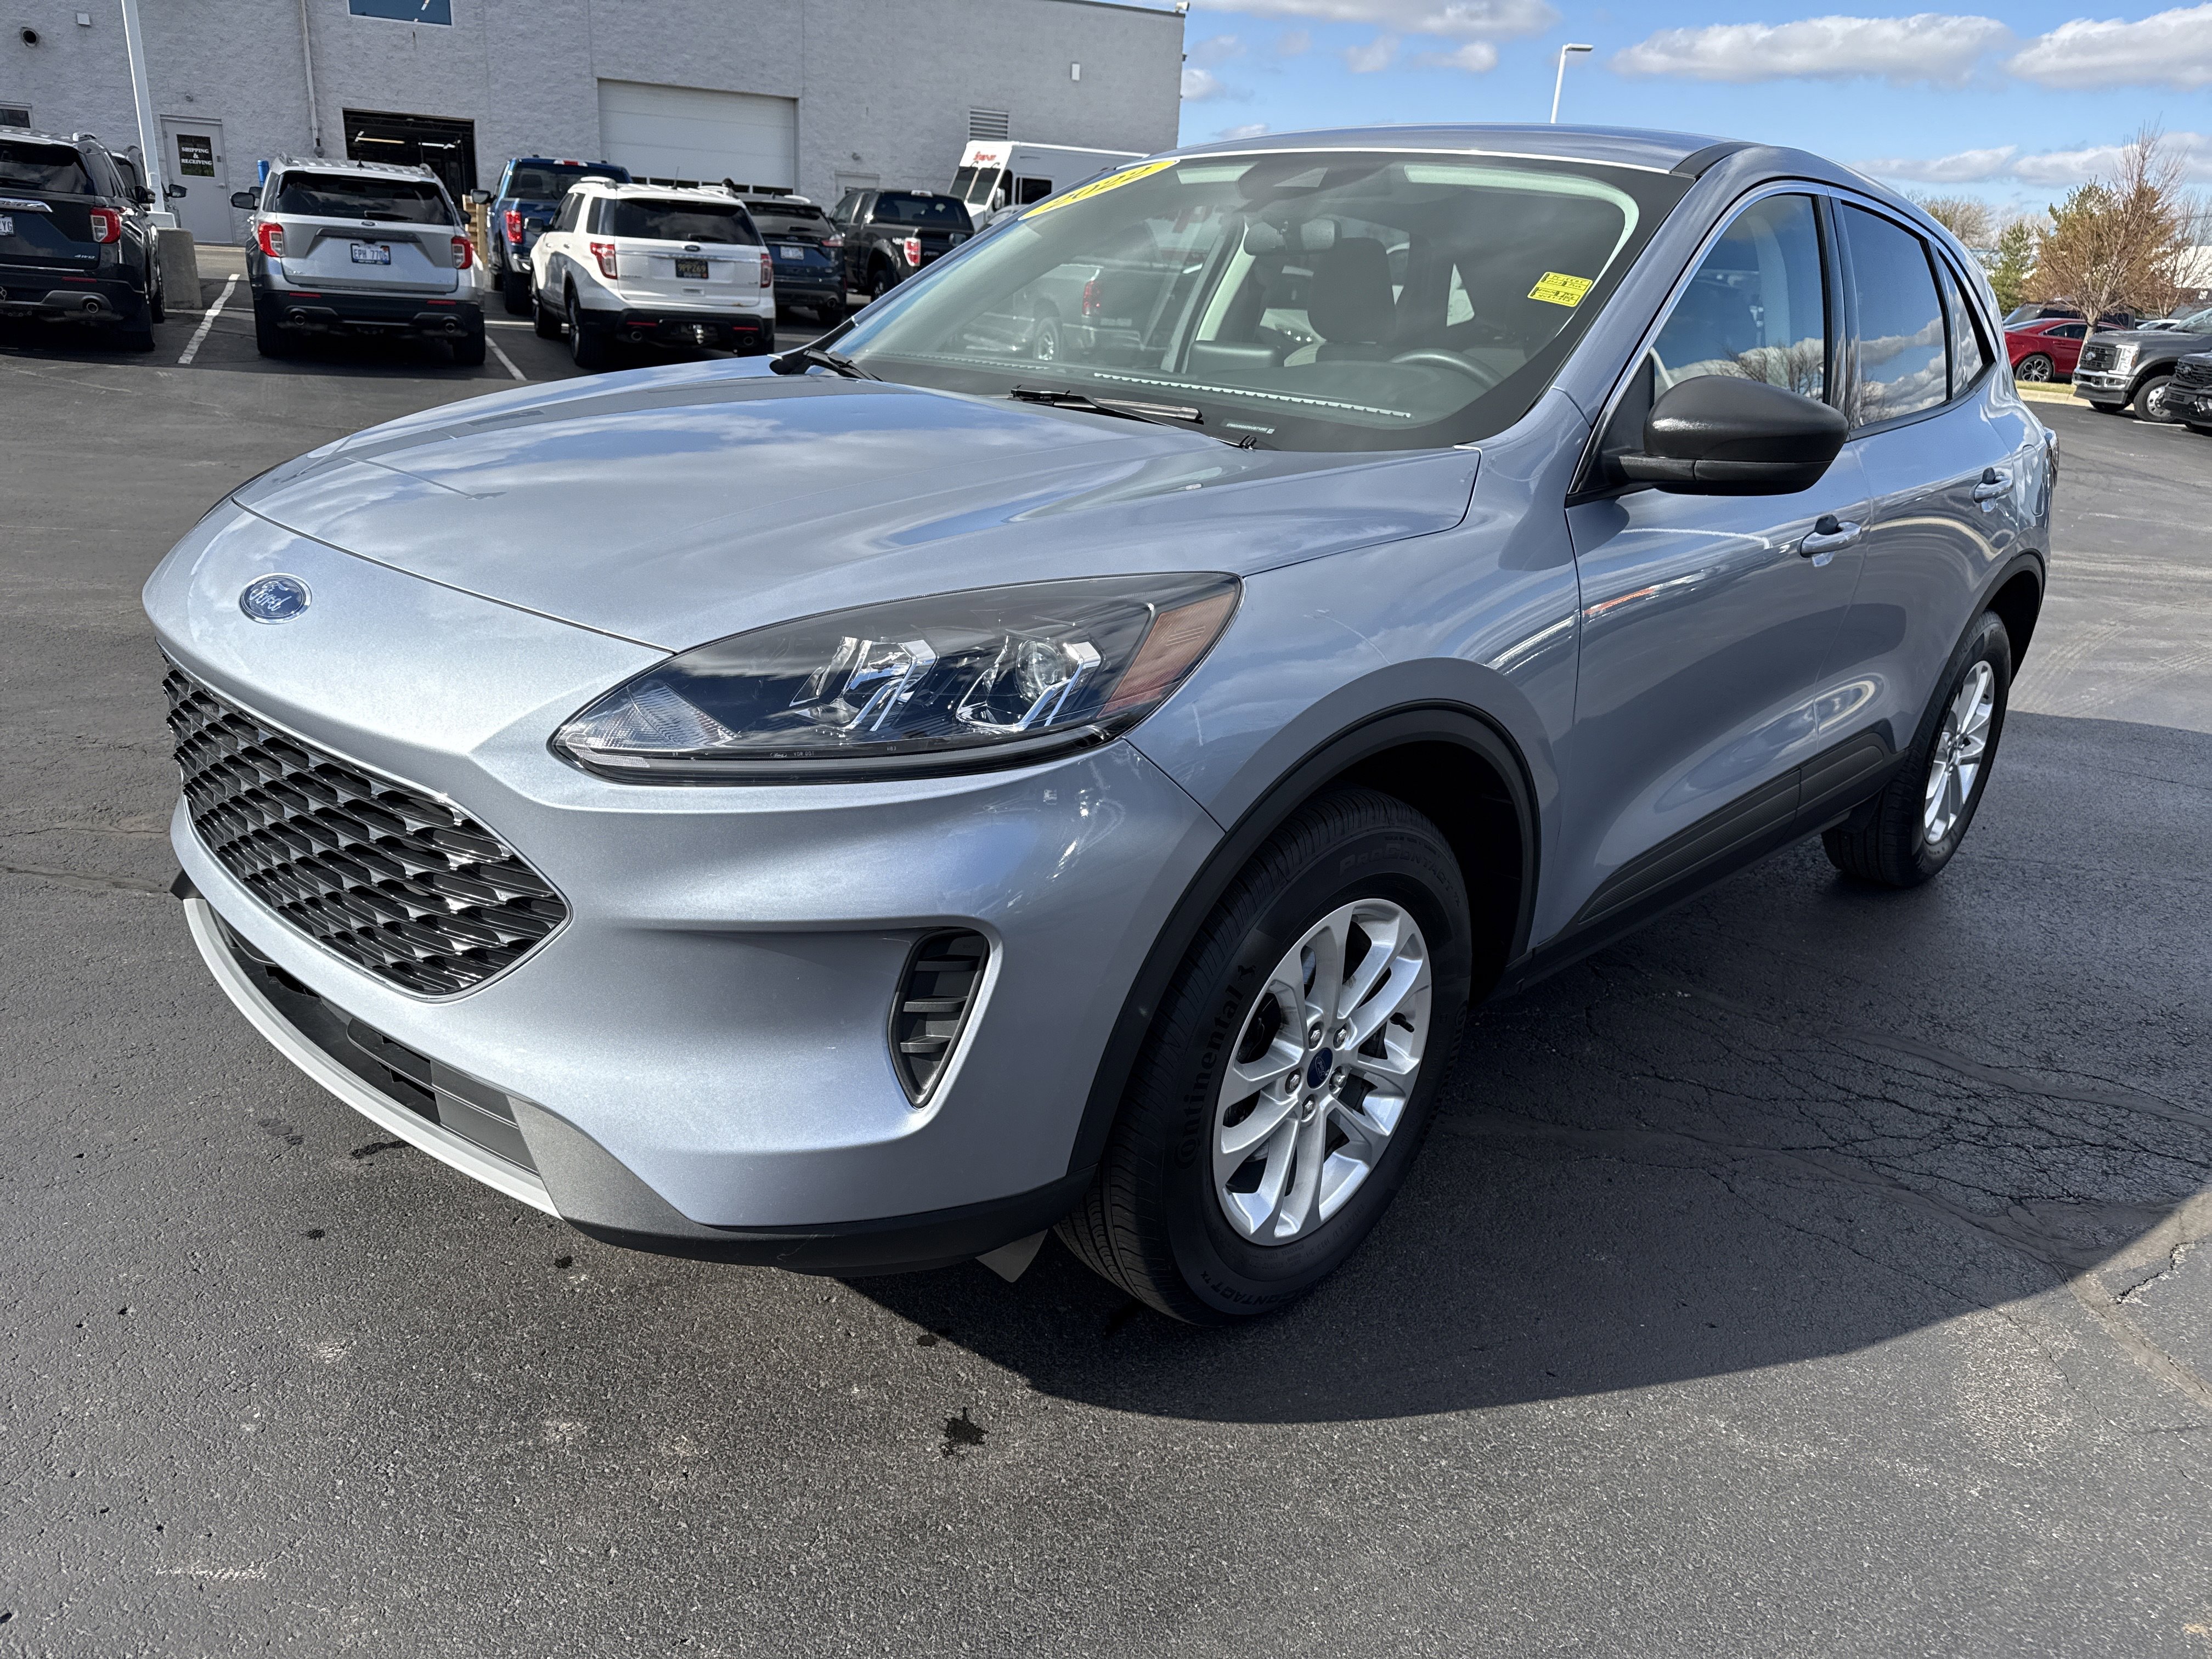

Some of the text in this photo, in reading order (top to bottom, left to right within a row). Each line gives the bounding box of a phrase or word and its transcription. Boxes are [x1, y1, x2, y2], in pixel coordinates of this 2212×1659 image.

[1042, 166, 1152, 211] 2022
[354, 249, 366, 258] EPH
[250, 580, 292, 611] Ford
[1173, 984, 1245, 1170] Continental
